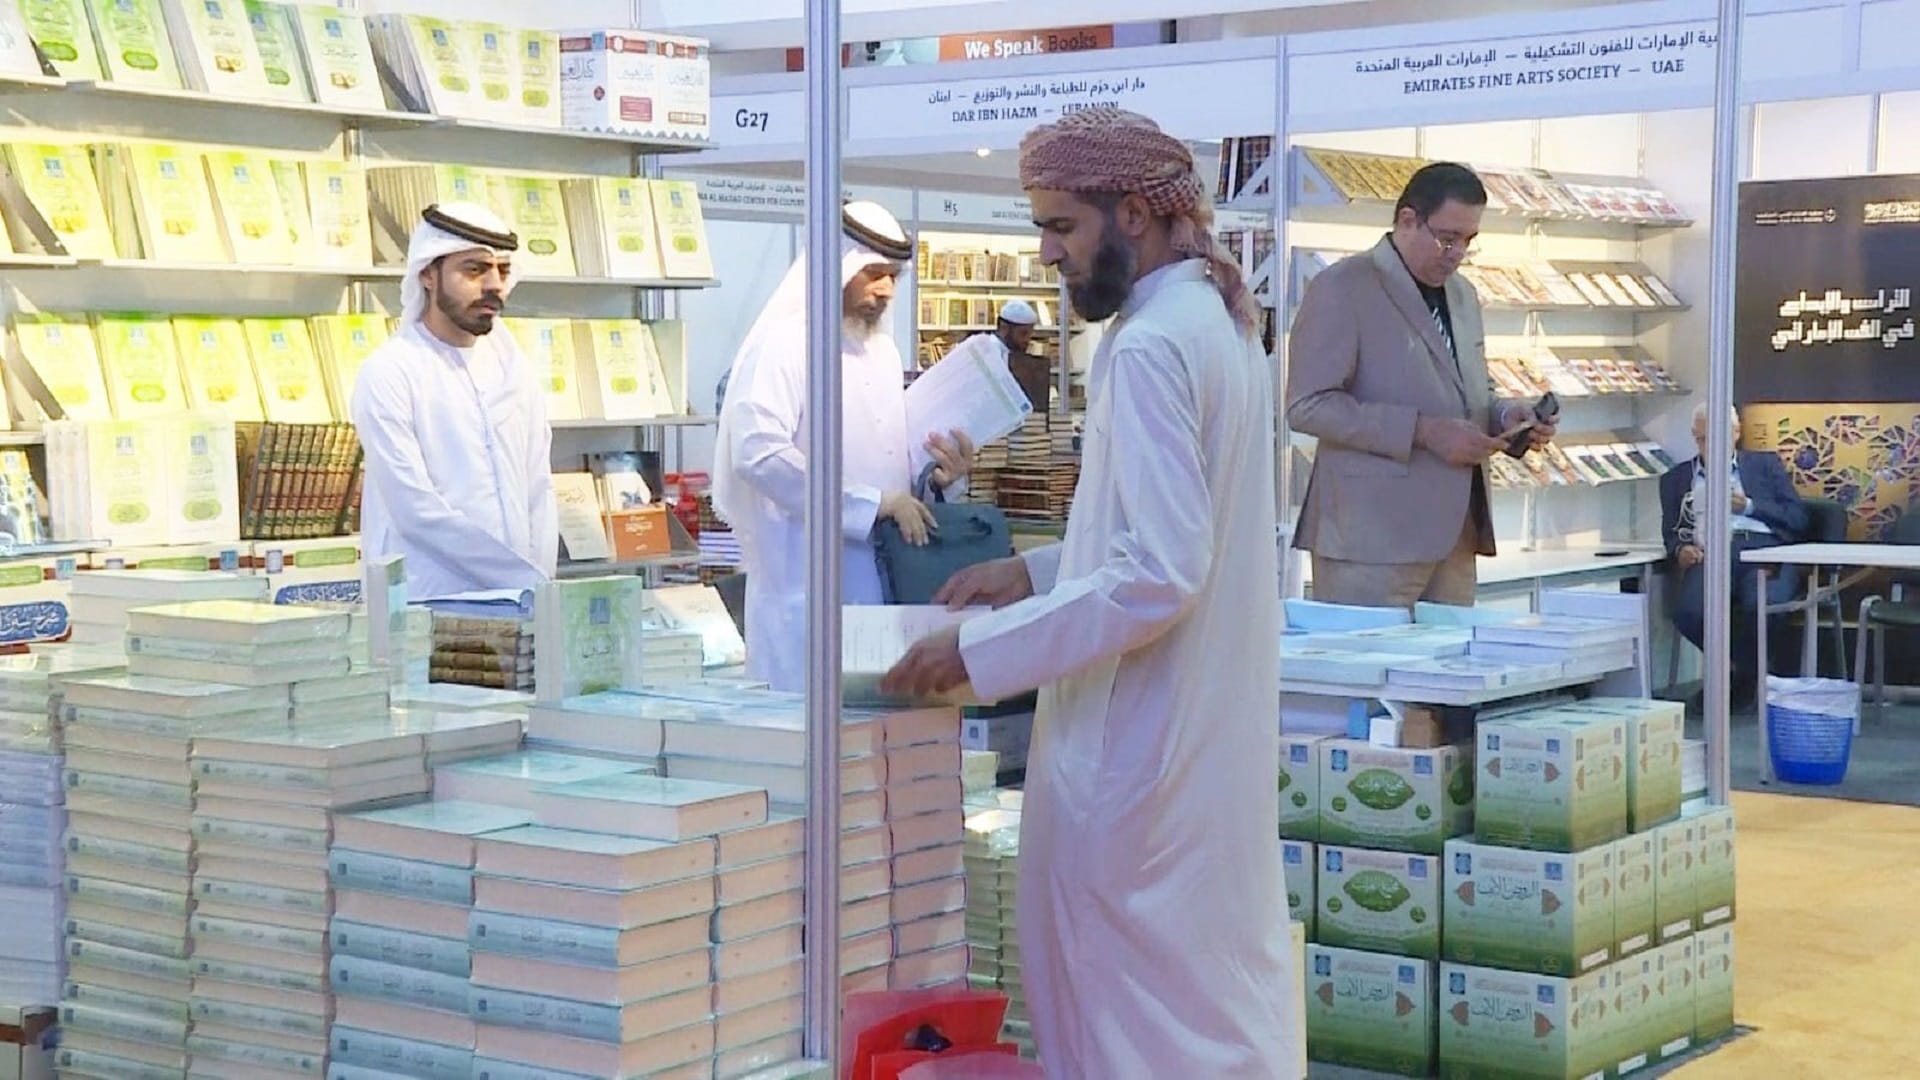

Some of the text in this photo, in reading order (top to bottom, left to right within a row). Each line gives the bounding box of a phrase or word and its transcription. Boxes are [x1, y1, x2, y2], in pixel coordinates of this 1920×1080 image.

[965, 32, 1097, 60] We Speak Books
[1589, 36, 1633, 58] للفنون
[1638, 31, 1693, 52] الإمارات
[1446, 49, 1496, 68] الإمارات
[1524, 41, 1585, 62] التشكيلية
[1355, 58, 1400, 73] المتحدة
[1403, 54, 1442, 73] العربية
[1111, 78, 1129, 92] ابن
[1131, 75, 1145, 90] دار
[1404, 76, 1475, 95] EMIRATES
[1479, 72, 1513, 89] FINE
[1516, 69, 1554, 85] ARTS
[1558, 64, 1621, 83] SOCIETY
[1652, 59, 1685, 74] UAE
[973, 88, 1012, 104] والتوزيع
[1014, 85, 1047, 99] والنشر
[1050, 81, 1087, 94] للطباعة
[1089, 81, 1109, 97] حزم
[928, 90, 951, 105] لبنان
[735, 108, 769, 132] G27
[952, 108, 976, 122] DAR
[978, 107, 999, 121] IBN
[1001, 105, 1037, 120] HAZM
[944, 199, 959, 217] H5
[1882, 317, 1915, 348] في
